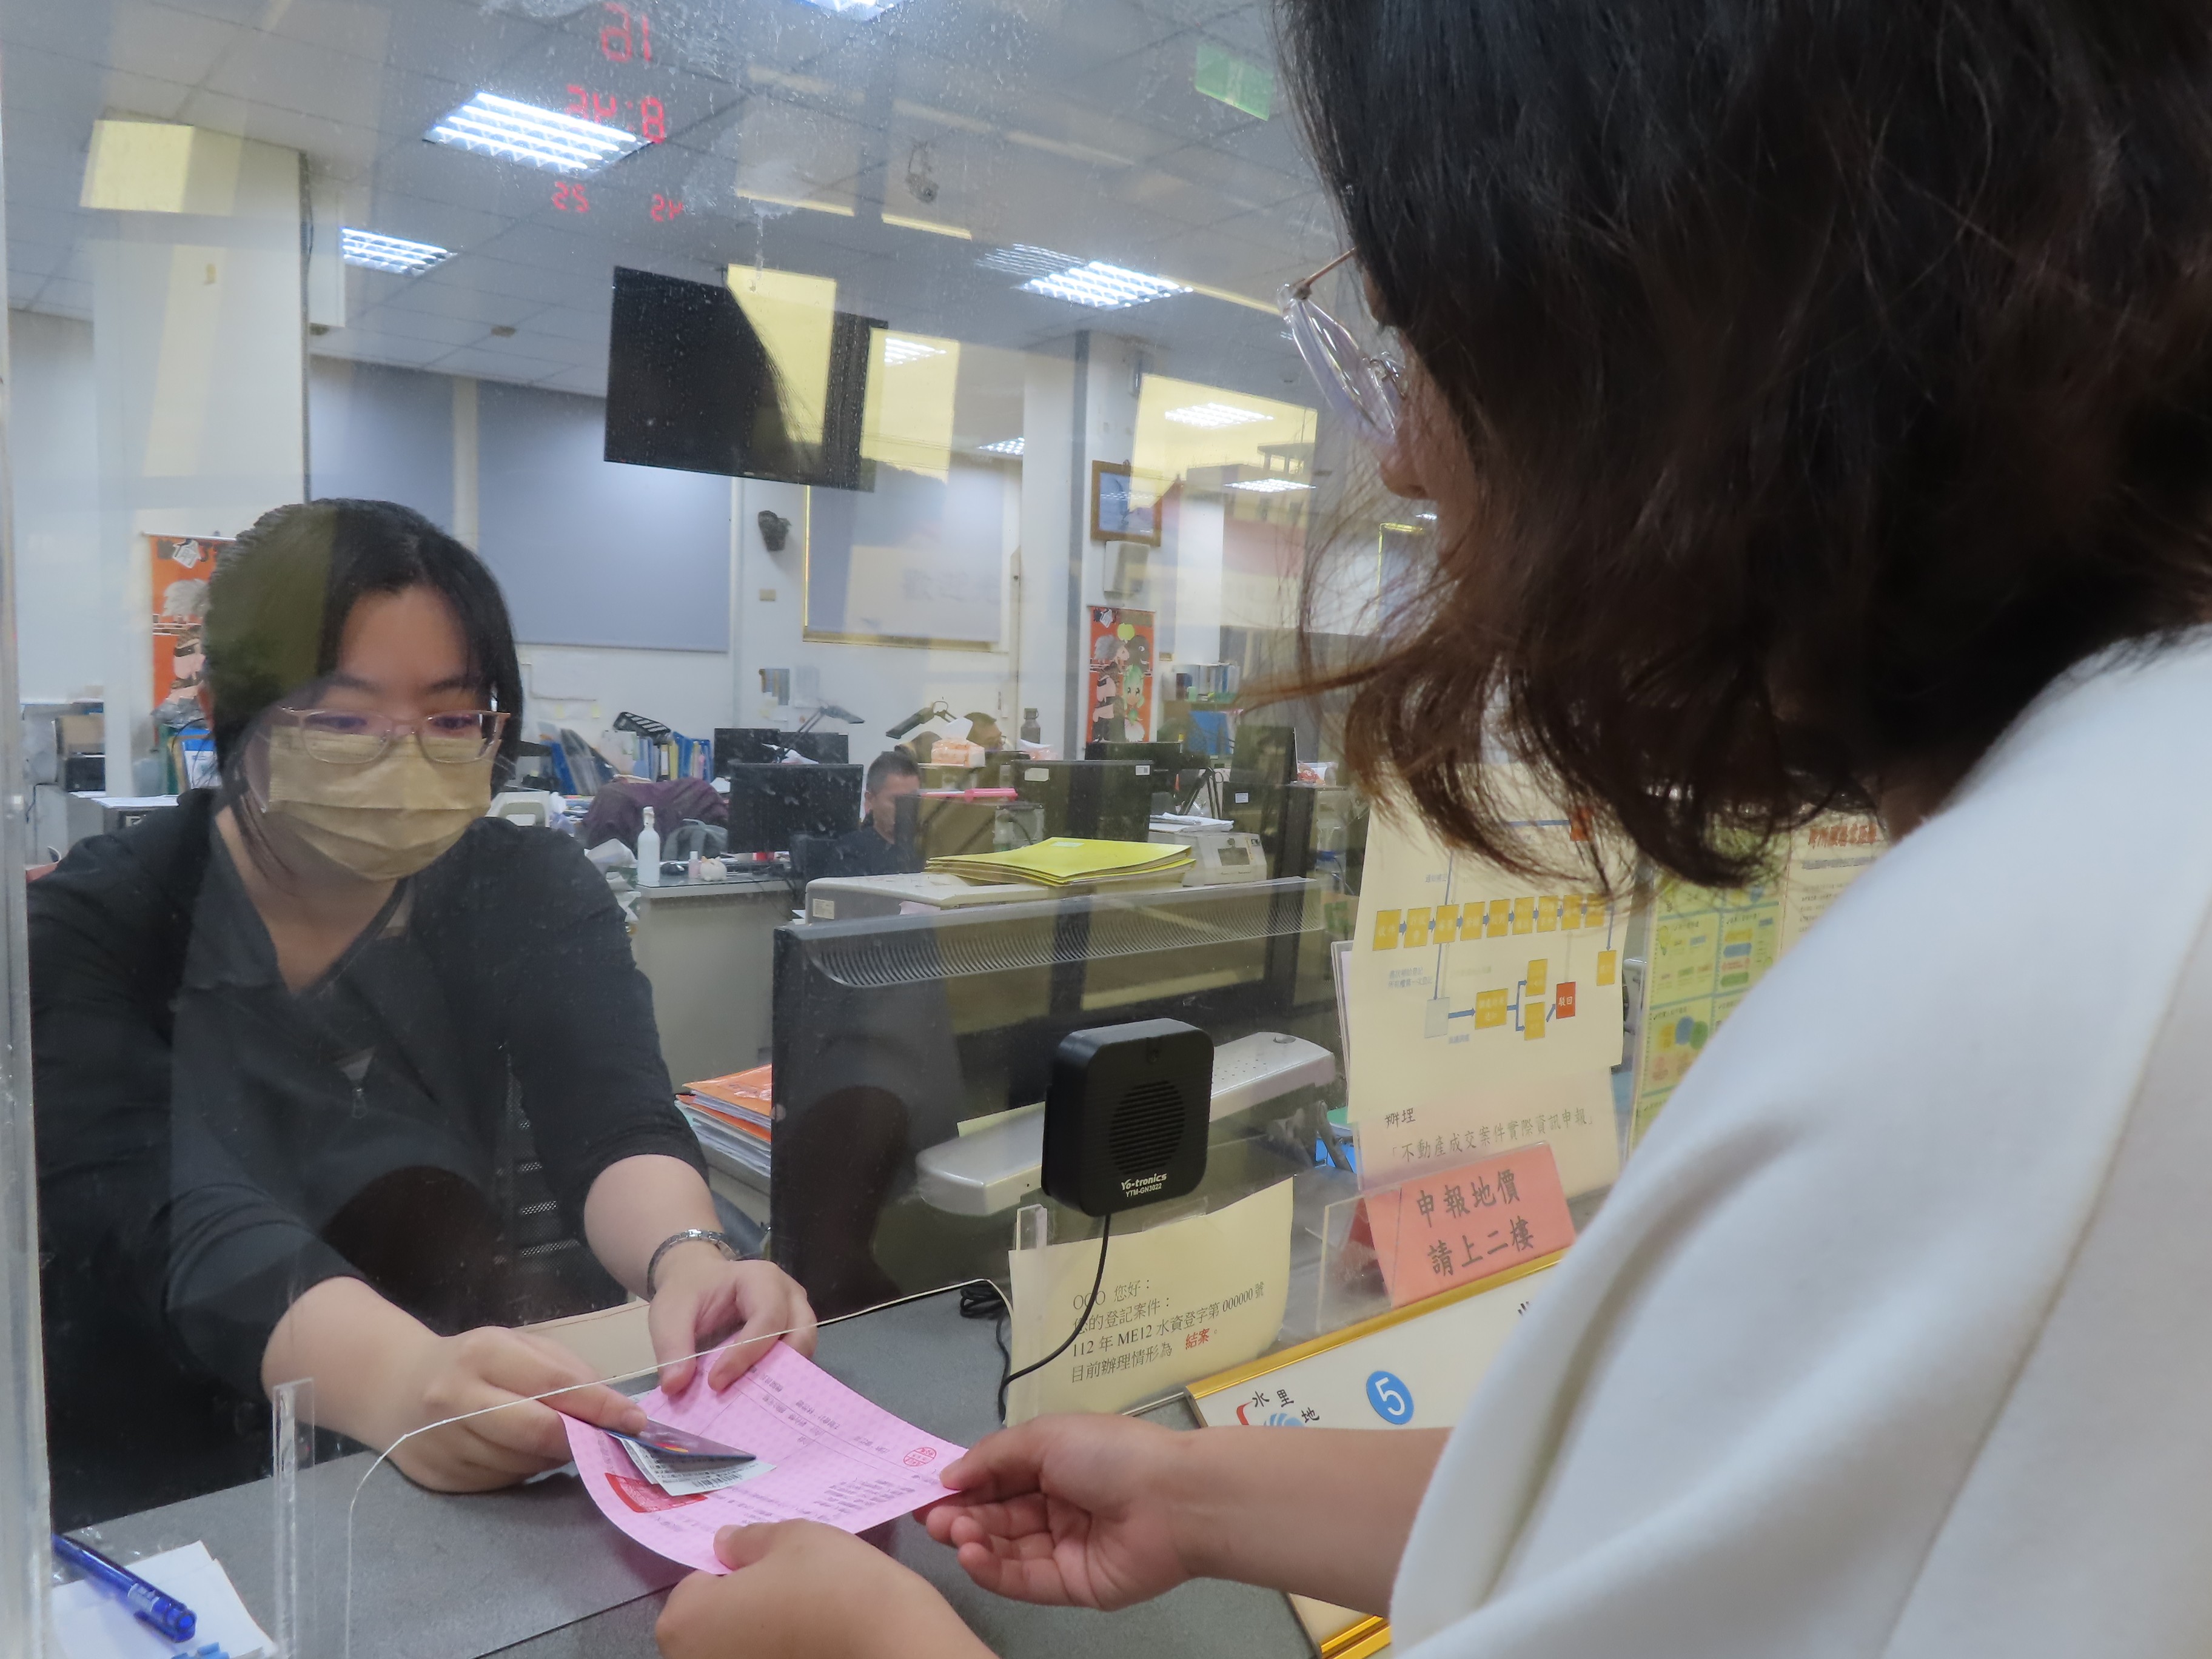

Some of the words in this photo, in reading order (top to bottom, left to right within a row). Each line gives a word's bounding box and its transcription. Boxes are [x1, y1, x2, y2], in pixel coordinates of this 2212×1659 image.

[1558, 996, 1573, 1007] 駁回
[1121, 1173, 1168, 1191] Yo-tronics
[1416, 1168, 1520, 1228] 申報地價
[1427, 1215, 1534, 1277] 請上二樓
[1073, 1340, 1094, 1358] 112
[1098, 1335, 1113, 1352] 年
[1117, 1324, 1152, 1347] ME12
[1222, 1287, 1253, 1312] 000000
[1255, 1281, 1264, 1299] 號
[1071, 1341, 1173, 1384] 目前辦理情形為
[1252, 1389, 1320, 1424] 水里地
[1374, 1376, 1406, 1416] 5
